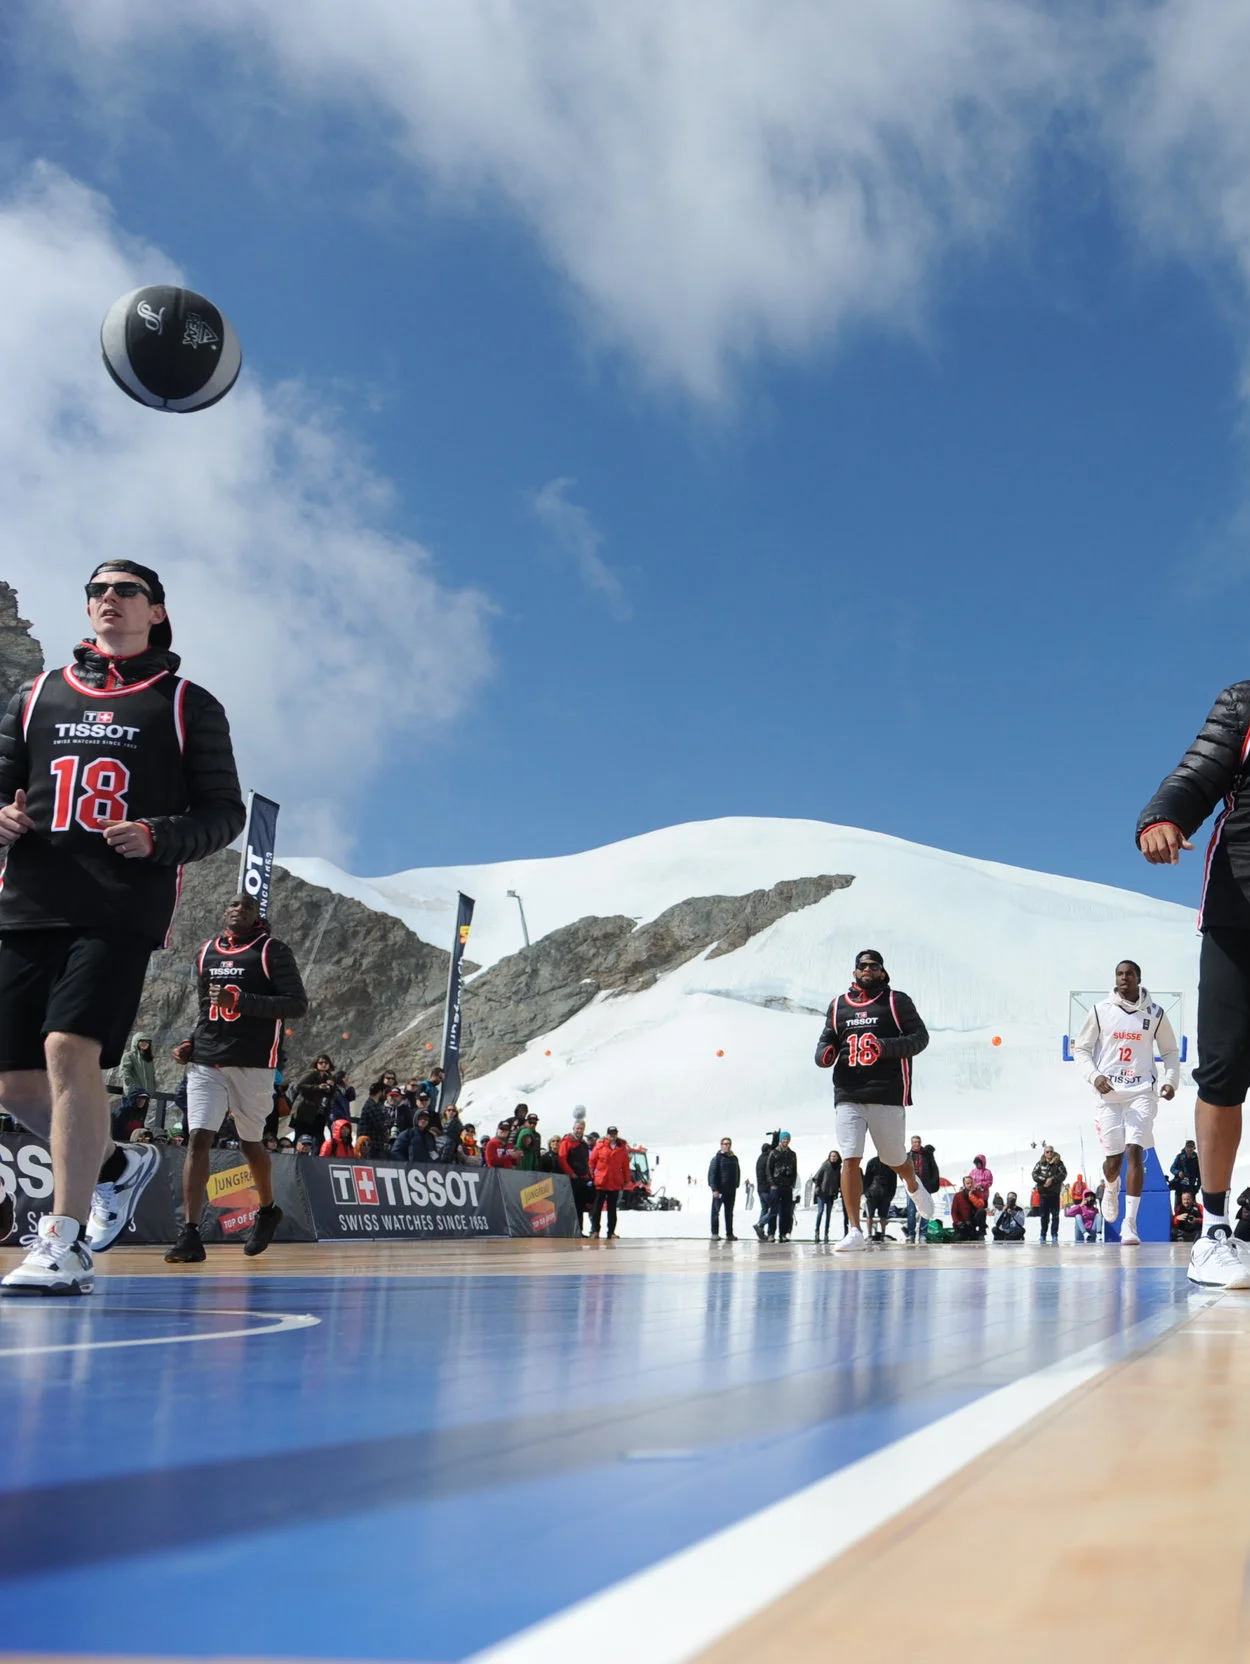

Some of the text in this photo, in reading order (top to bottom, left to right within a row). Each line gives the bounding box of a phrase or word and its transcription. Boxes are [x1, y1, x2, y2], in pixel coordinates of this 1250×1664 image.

[55, 723, 140, 740] TISSOT
[50, 755, 130, 833] 18
[846, 1017, 878, 1026] TISSOT
[846, 1032, 877, 1066] 18
[1119, 1047, 1132, 1062] 12
[1108, 1075, 1142, 1084] TISSOT
[375, 1167, 479, 1207] TISSOT
[223, 1218, 237, 1229] TOP
[237, 1213, 248, 1224] OF
[338, 1214, 489, 1231] SWISS WATCHES SINCE 1853
